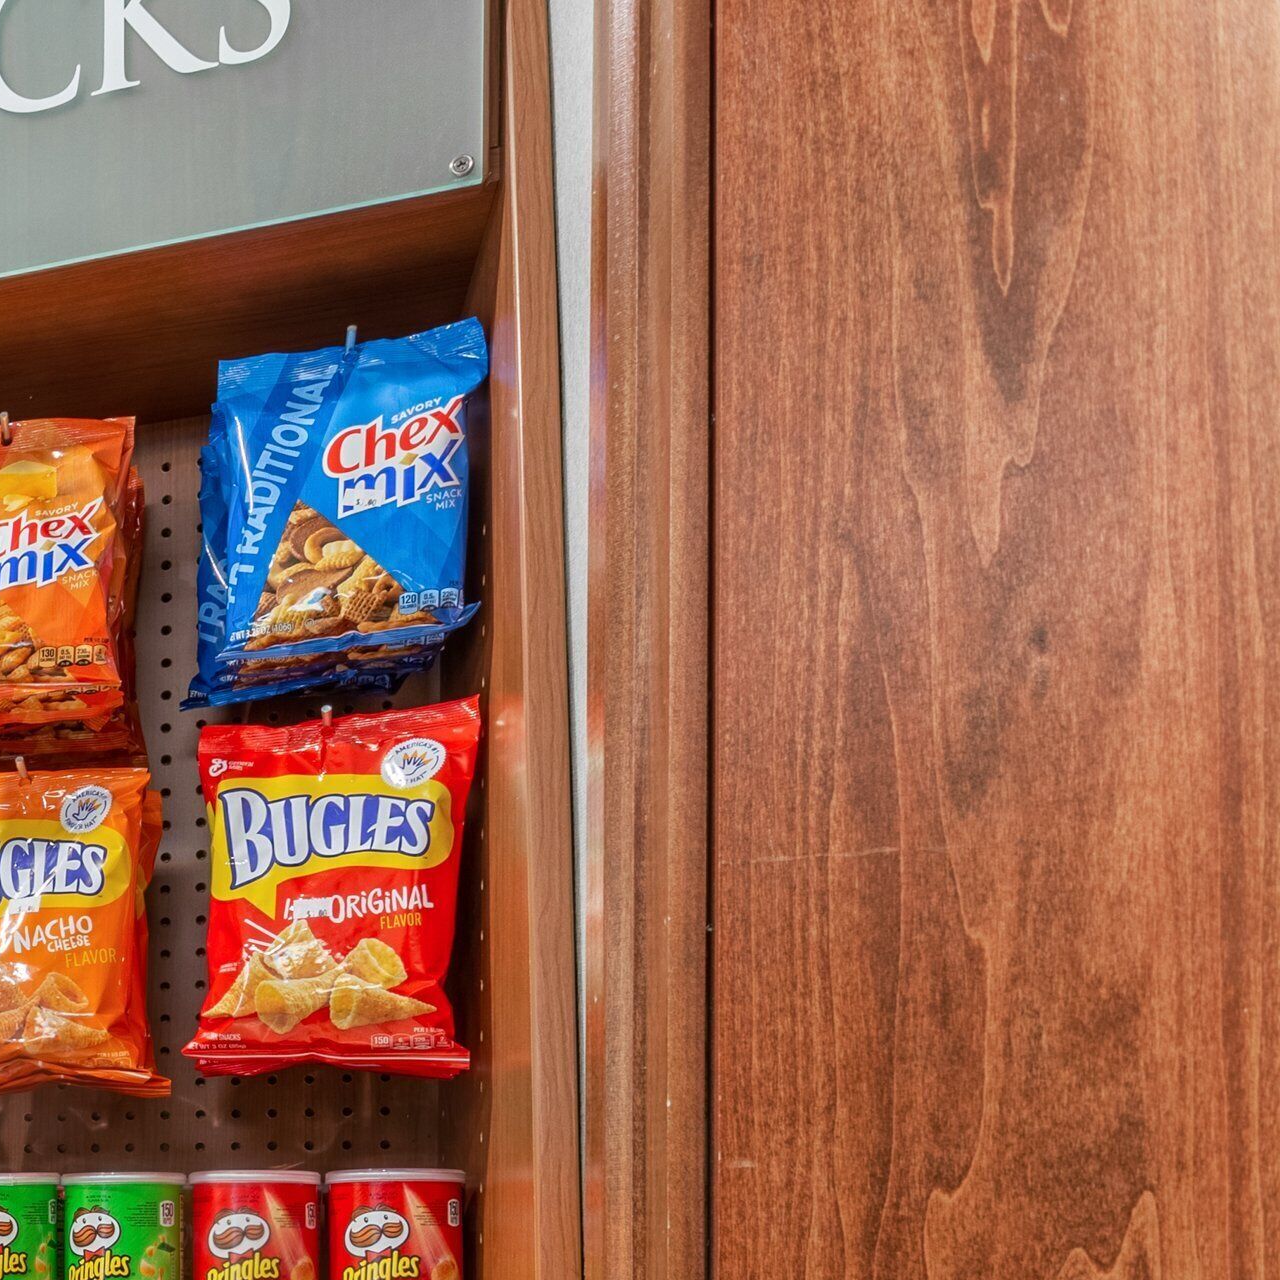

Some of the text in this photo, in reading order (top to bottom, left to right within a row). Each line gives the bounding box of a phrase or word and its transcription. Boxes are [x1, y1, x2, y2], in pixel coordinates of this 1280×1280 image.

[237, 363, 339, 573] TRADITIONAL
[425, 489, 462, 503] SNACK
[435, 499, 456, 510] MIX
[401, 594, 416, 605] 120
[219, 788, 435, 889] BUGLES
[379, 913, 422, 929] FLAVOR
[13, 915, 93, 955] NACHO
[47, 934, 90, 953] CHEESE
[65, 948, 117, 968] FLAVOR
[374, 1036, 389, 1045] 150
